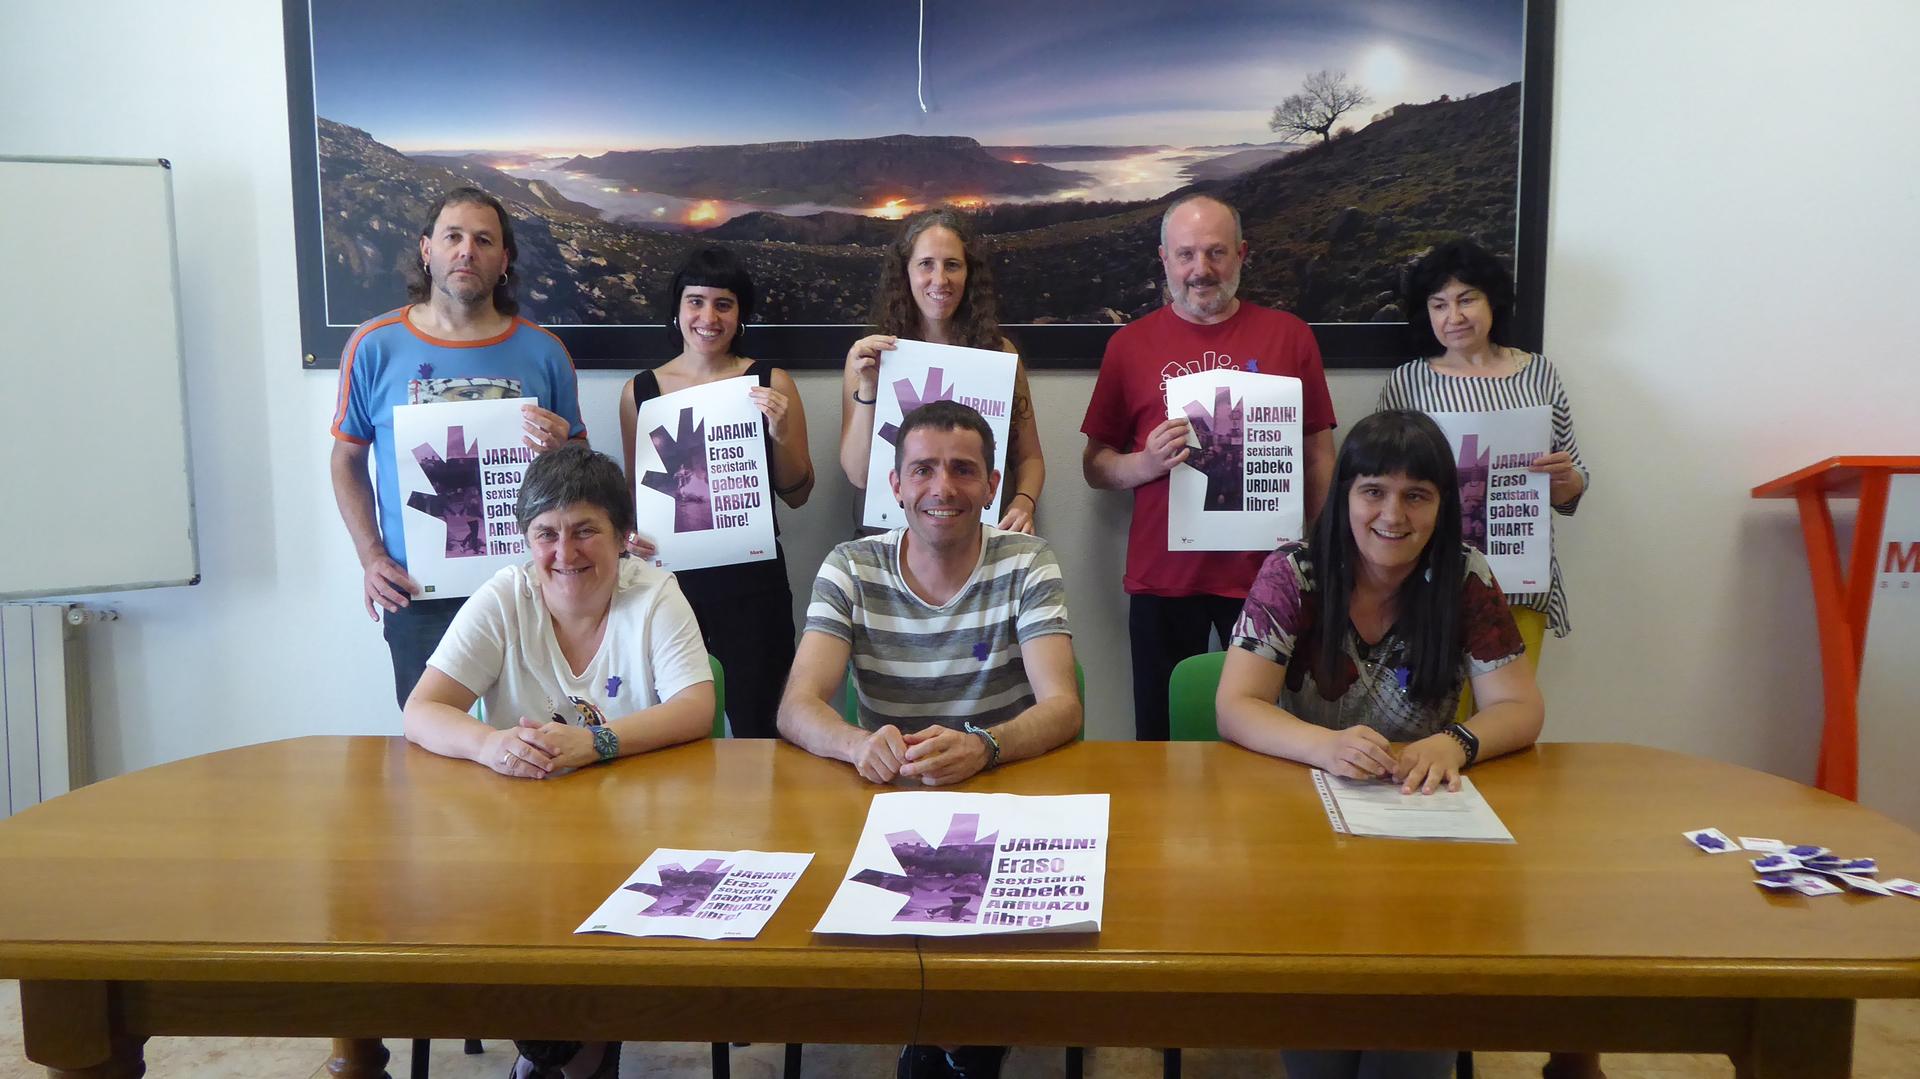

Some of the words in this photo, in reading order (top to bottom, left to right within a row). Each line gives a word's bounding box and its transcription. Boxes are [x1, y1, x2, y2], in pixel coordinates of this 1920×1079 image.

[1247, 407, 1297, 423] JARAIN!
[708, 422, 757, 442] JARAIN!
[1247, 428, 1281, 442] Eraso
[709, 446, 744, 461] Eraso
[1247, 445, 1293, 457] sexistarik
[710, 459, 757, 474] sexistarik
[1246, 459, 1292, 475] gabeko
[484, 470, 521, 486] Eraso
[712, 475, 759, 493] gabeko
[1491, 473, 1527, 488] Eraso
[485, 487, 520, 500] sexista
[1246, 479, 1290, 493] URDIAIN
[714, 492, 760, 512] ARBIZU
[1490, 489, 1539, 501] sexistarik
[1246, 497, 1279, 511] libre!
[1490, 503, 1539, 520] gabeko
[716, 512, 749, 529] libre!
[489, 521, 523, 537] ARRU
[1490, 522, 1534, 537] UHARTE
[490, 539, 525, 555] libre!
[1490, 540, 1525, 555] libre!
[1000, 838, 1097, 852] JARAIN!
[997, 857, 1065, 874] Eraso
[730, 869, 796, 880] JARAIN!
[994, 875, 1086, 886] sexistarik
[717, 886, 779, 895] sexistarik
[723, 878, 769, 888] Eraso
[711, 893, 774, 903] gabeko
[990, 884, 1085, 898] gabeko
[985, 900, 1090, 911] ARRUAZU
[982, 911, 1052, 928] libre!
